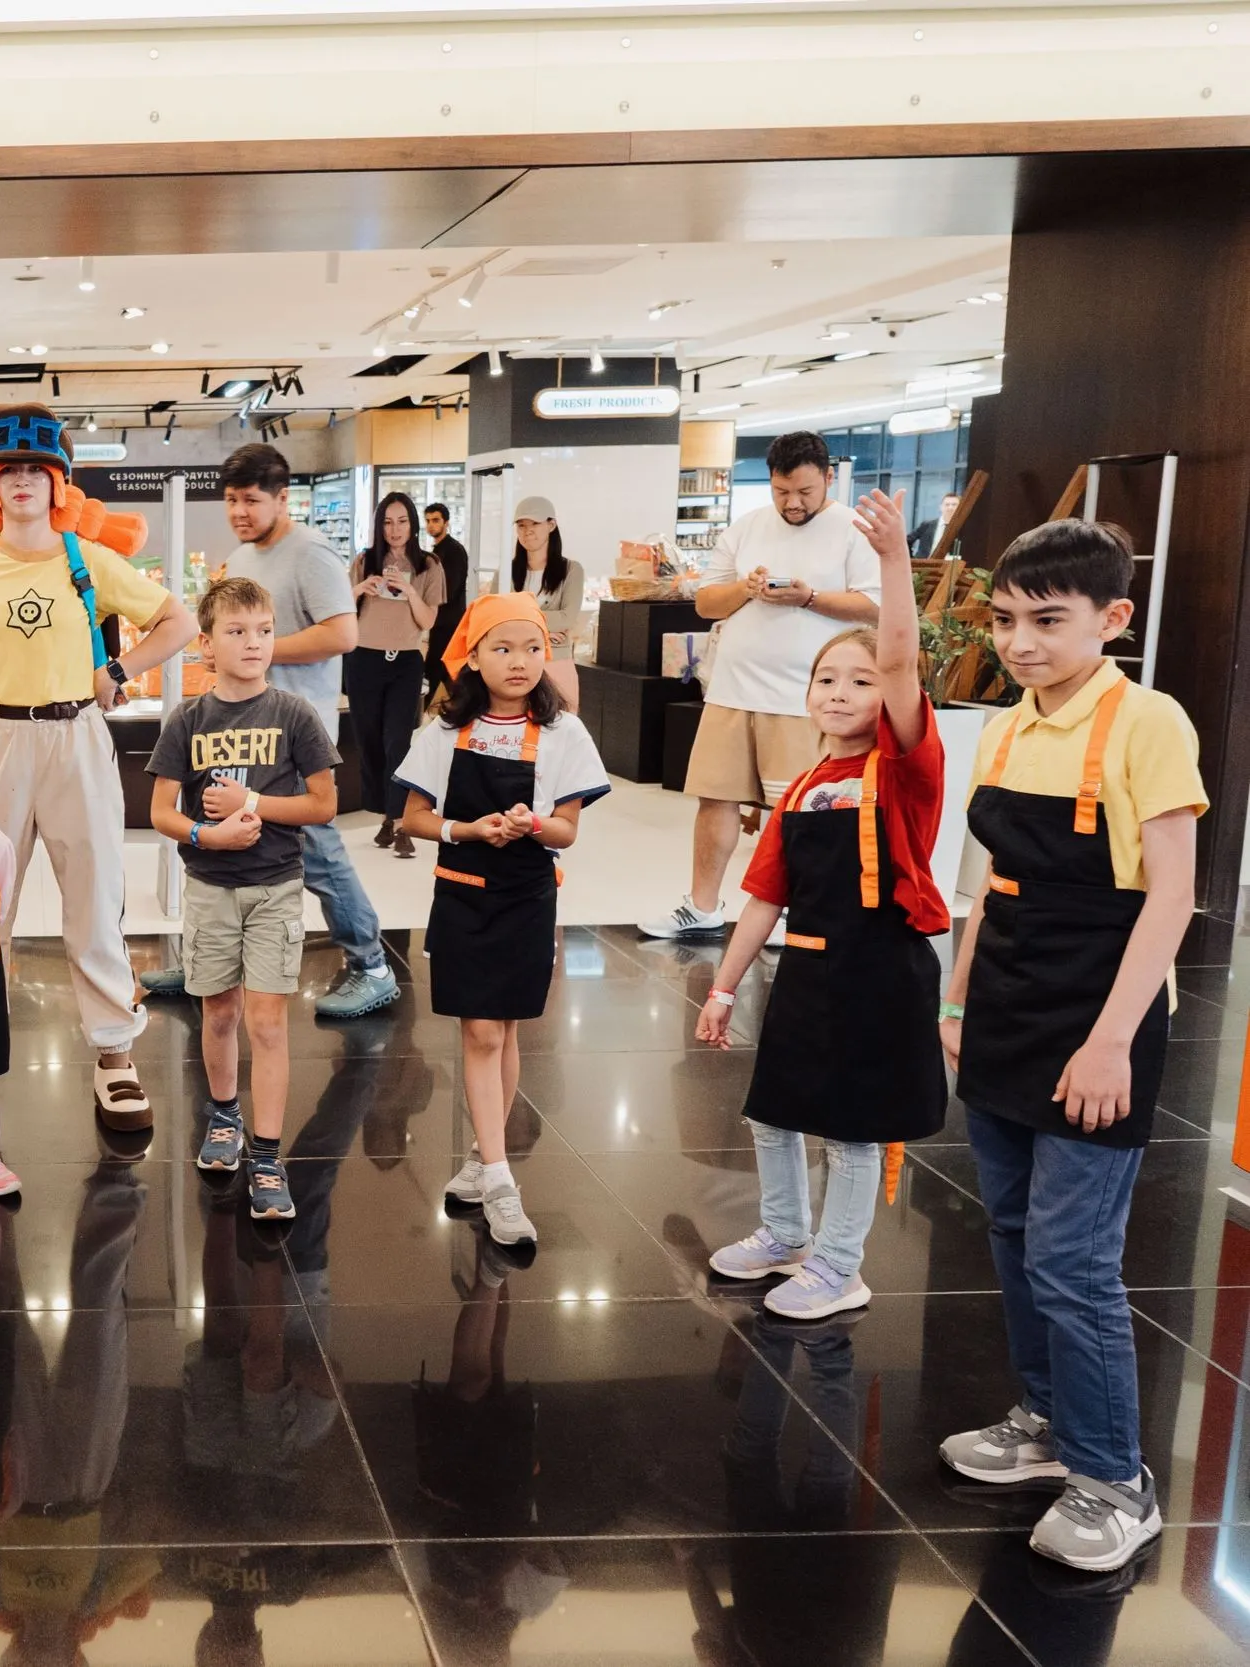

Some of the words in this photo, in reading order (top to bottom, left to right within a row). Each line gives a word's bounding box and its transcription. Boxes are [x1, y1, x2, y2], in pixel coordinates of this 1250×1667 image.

[554, 397, 592, 409] FRESH
[599, 395, 664, 408] PRODUCTS
[116, 482, 163, 492] SEASONA
[185, 481, 217, 490] ODUCE
[191, 727, 283, 772] DESERT
